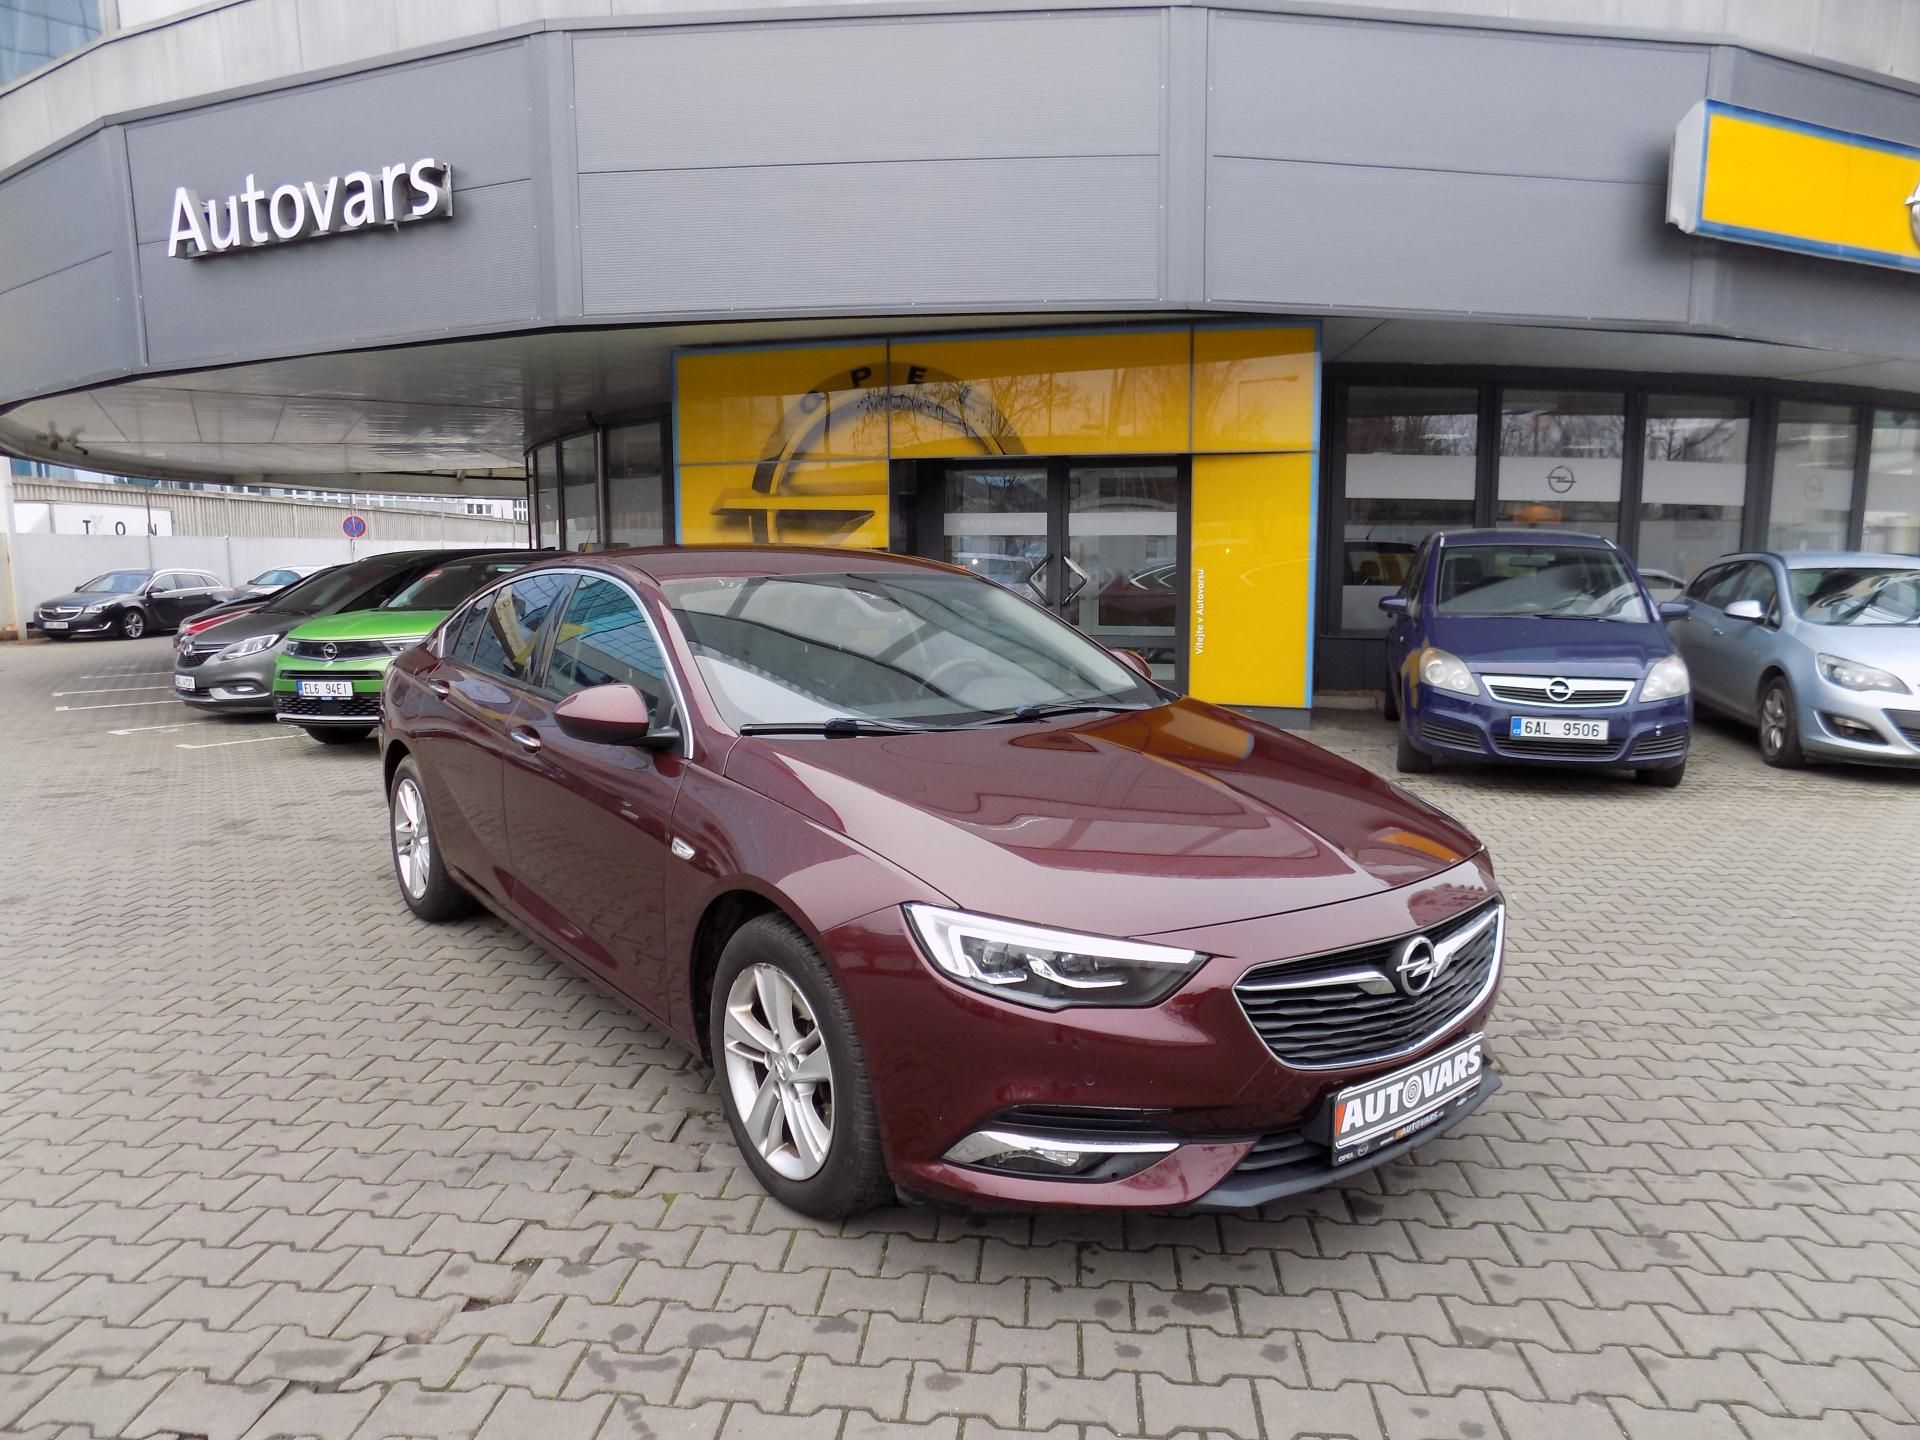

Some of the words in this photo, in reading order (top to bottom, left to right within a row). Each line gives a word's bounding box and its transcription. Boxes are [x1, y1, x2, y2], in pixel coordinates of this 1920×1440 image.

[168, 157, 438, 257] Autovars
[1196, 569, 1204, 616] Autovarsu
[1524, 721, 1551, 735] 6AL
[1563, 723, 1600, 737] 9506
[1340, 1044, 1482, 1134] AUTOVARS
